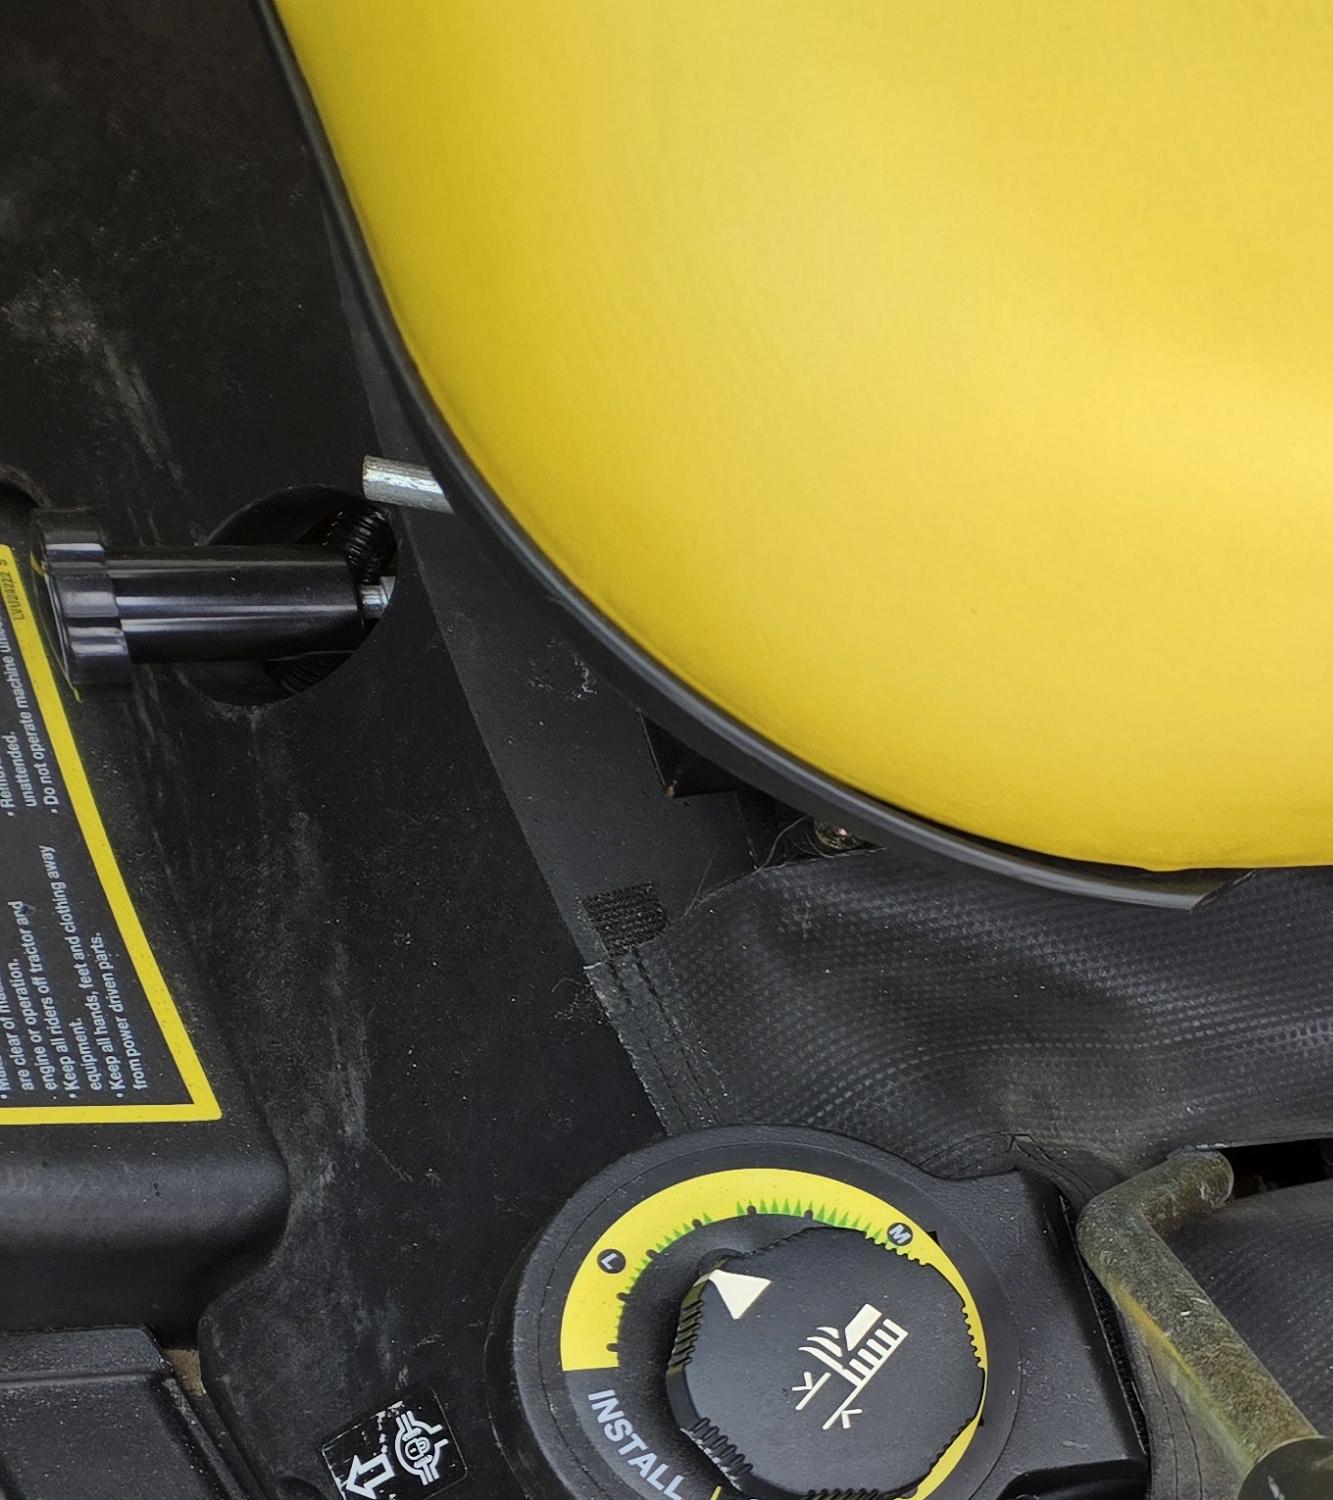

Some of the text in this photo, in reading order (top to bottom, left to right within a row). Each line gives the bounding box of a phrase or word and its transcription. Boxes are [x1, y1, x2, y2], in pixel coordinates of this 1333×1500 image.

[2, 656, 29, 709] machine
[19, 711, 45, 760] operate
[2, 731, 37, 807] unattended.
[33, 763, 52, 784] not
[43, 786, 59, 805] Do
[38, 845, 126, 1090] Keep all hands, feet and clothing away
[8, 901, 80, 1090] Keep all riders off tractor and
[90, 932, 148, 1090] from power driven parts.
[6, 1032, 27, 1065] clear
[8, 958, 57, 1090] engine or operation.
[68, 1018, 102, 1090] equipment.
[17, 1070, 35, 1090] are
[889, 1224, 911, 1244] M
[601, 1253, 618, 1270] L
